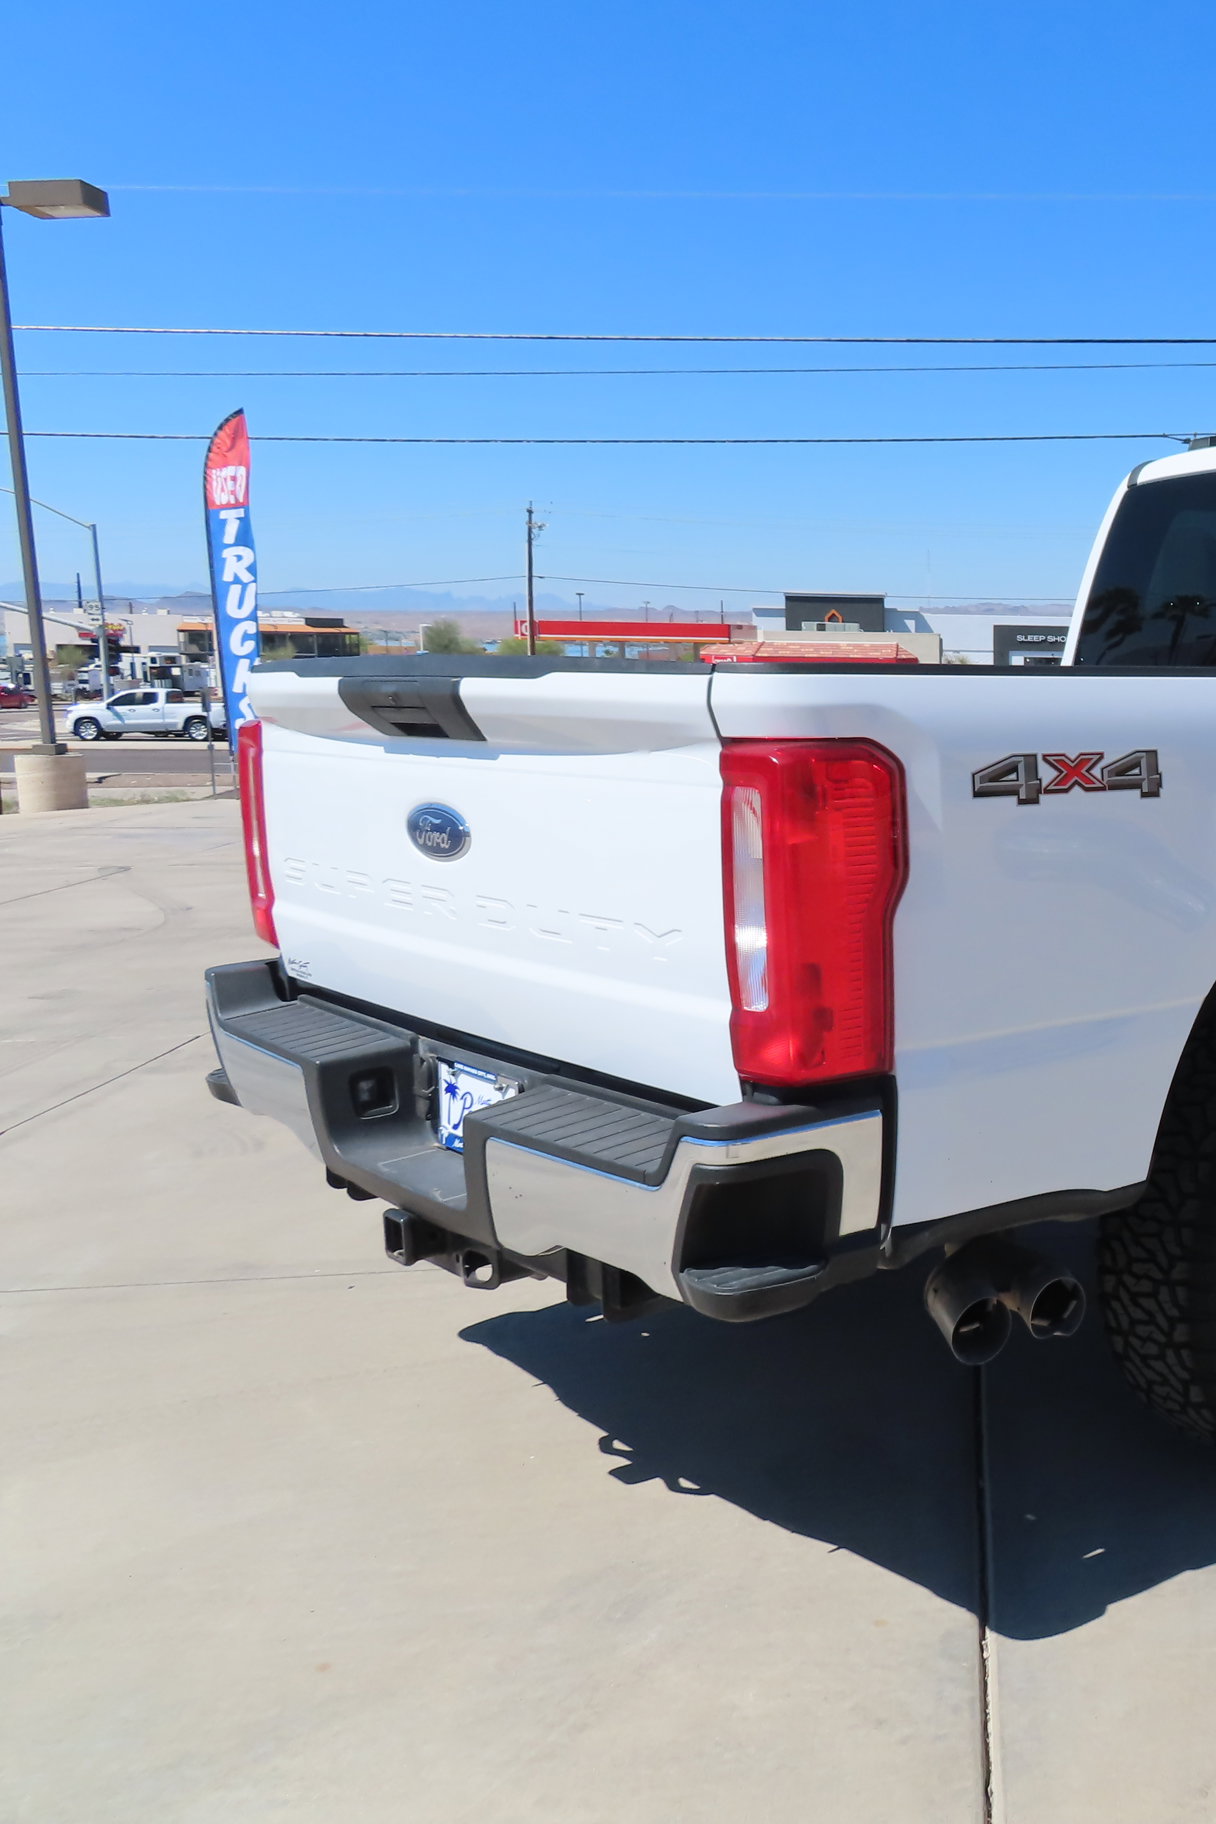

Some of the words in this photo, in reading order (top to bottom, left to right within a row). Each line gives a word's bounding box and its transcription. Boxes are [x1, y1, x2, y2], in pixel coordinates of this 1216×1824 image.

[212, 465, 246, 505] USED
[1016, 634, 1046, 642] SLEEP
[416, 815, 452, 848] Ford
[284, 856, 458, 921] SUPER
[474, 894, 683, 962] DUTY
